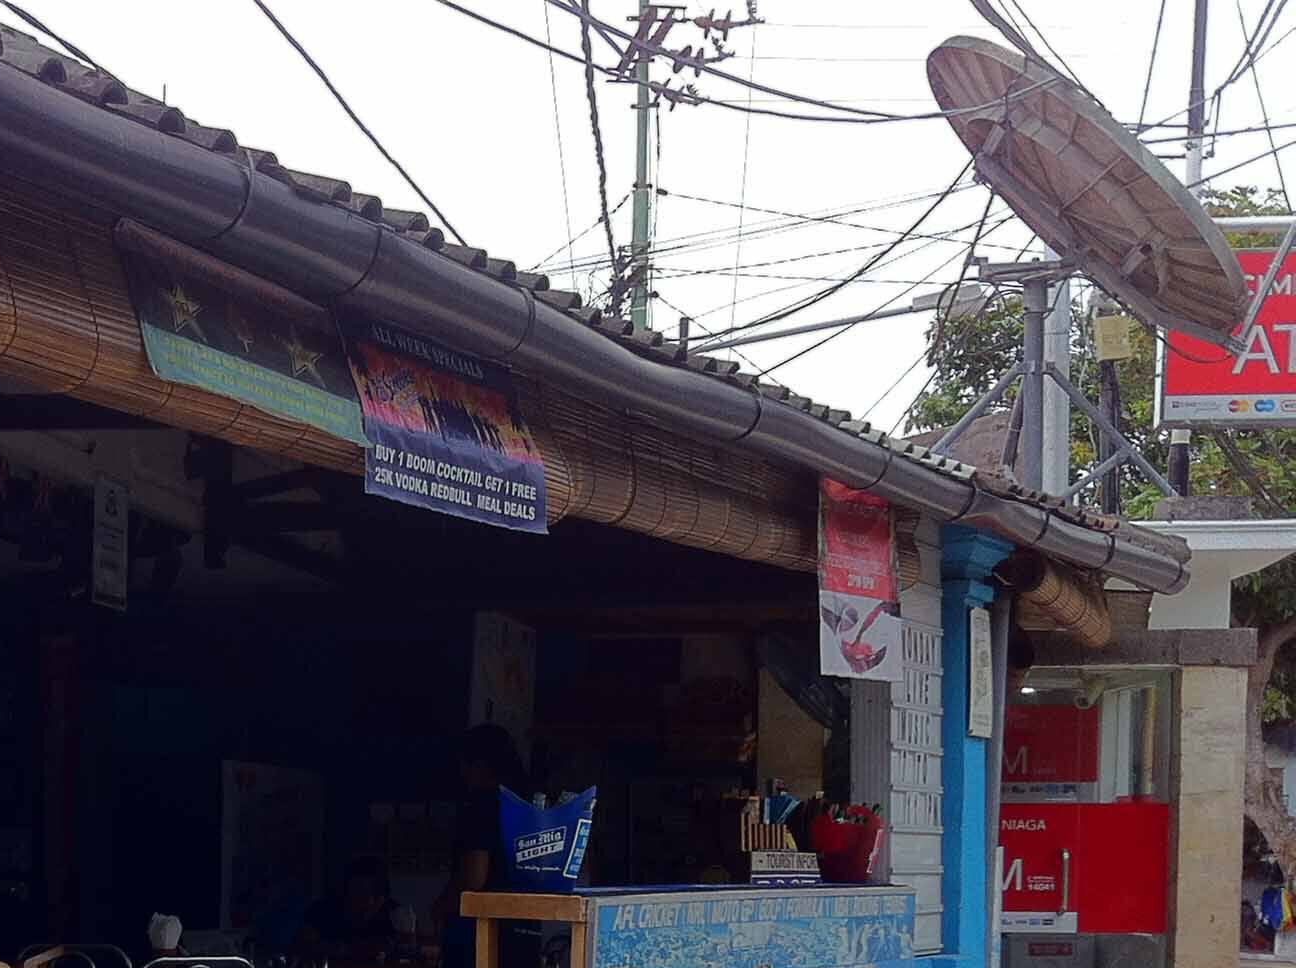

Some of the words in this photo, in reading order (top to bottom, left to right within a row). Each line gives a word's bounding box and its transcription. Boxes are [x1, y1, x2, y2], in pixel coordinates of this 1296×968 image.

[375, 444, 396, 464] BUY
[398, 454, 404, 467] 1
[406, 454, 435, 474] BOOM
[437, 462, 483, 487] COCKTAIL
[485, 475, 503, 493] GET
[512, 482, 537, 500] FREE
[375, 467, 393, 486] 25K
[395, 472, 428, 495] VODKA
[430, 482, 472, 506] REDBULL
[477, 494, 502, 514] MEAL
[504, 501, 536, 520] DEALS
[1002, 819, 1046, 831] NIAGA
[521, 844, 557, 858] LIGHT
[767, 853, 798, 869] TOURIST
[613, 905, 635, 930] AFL
[639, 903, 681, 928] CRICKET
